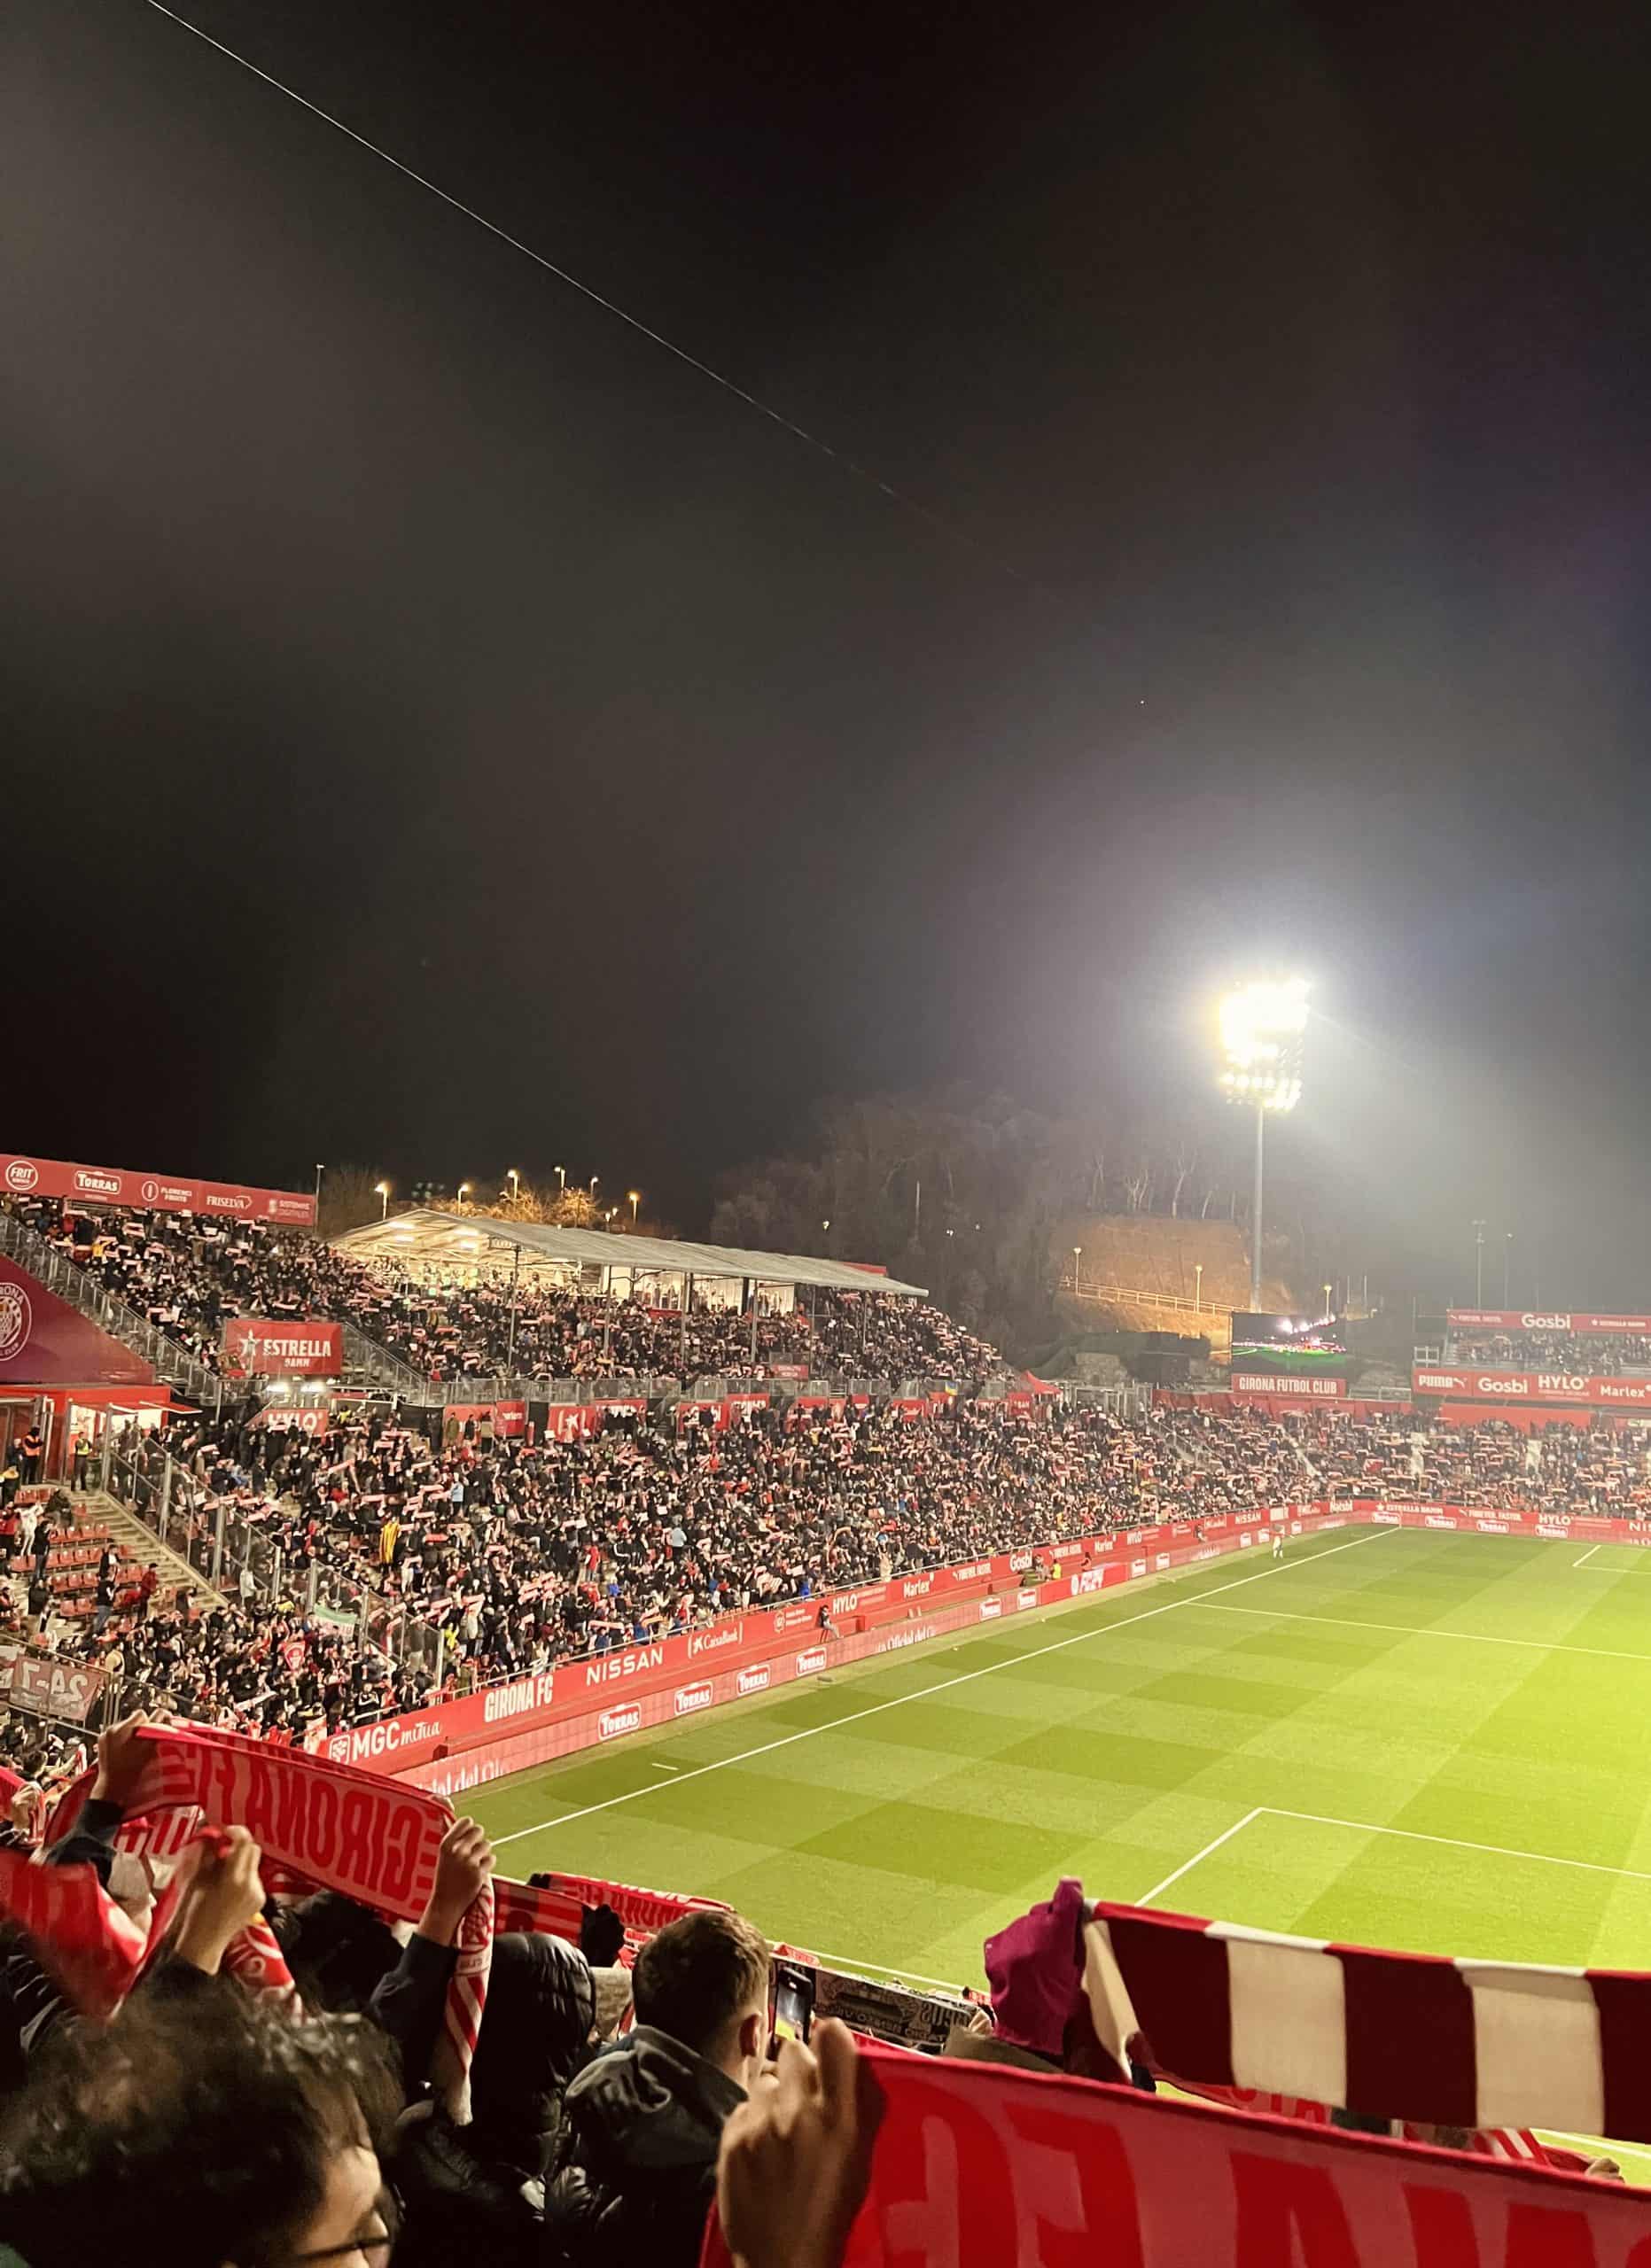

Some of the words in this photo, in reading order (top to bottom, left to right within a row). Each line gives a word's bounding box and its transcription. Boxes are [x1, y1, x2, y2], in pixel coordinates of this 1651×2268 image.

[11, 1167, 35, 1178] FRIT
[78, 1173, 118, 1192] TORRAS
[1521, 1314, 1570, 1330] Gosbi
[263, 1339, 331, 1357] ESTRELLA
[1240, 1377, 1274, 1390] GIRONA
[1277, 1379, 1311, 1392] FUTBOL
[1313, 1380, 1336, 1394] CLUB
[1477, 1377, 1528, 1394] Gosbi
[1600, 1385, 1645, 1398] Marlex
[903, 1580, 930, 1598] Marlex
[832, 1593, 858, 1615] HYLO
[586, 1646, 664, 1687] NISSAN
[738, 1671, 768, 1693] TORRAS
[485, 1680, 533, 1723] GIRONA
[536, 1674, 554, 1708] FC
[676, 1689, 710, 1712] TORRAS
[600, 1712, 639, 1737] TORRAS
[352, 1720, 401, 1761] MGC
